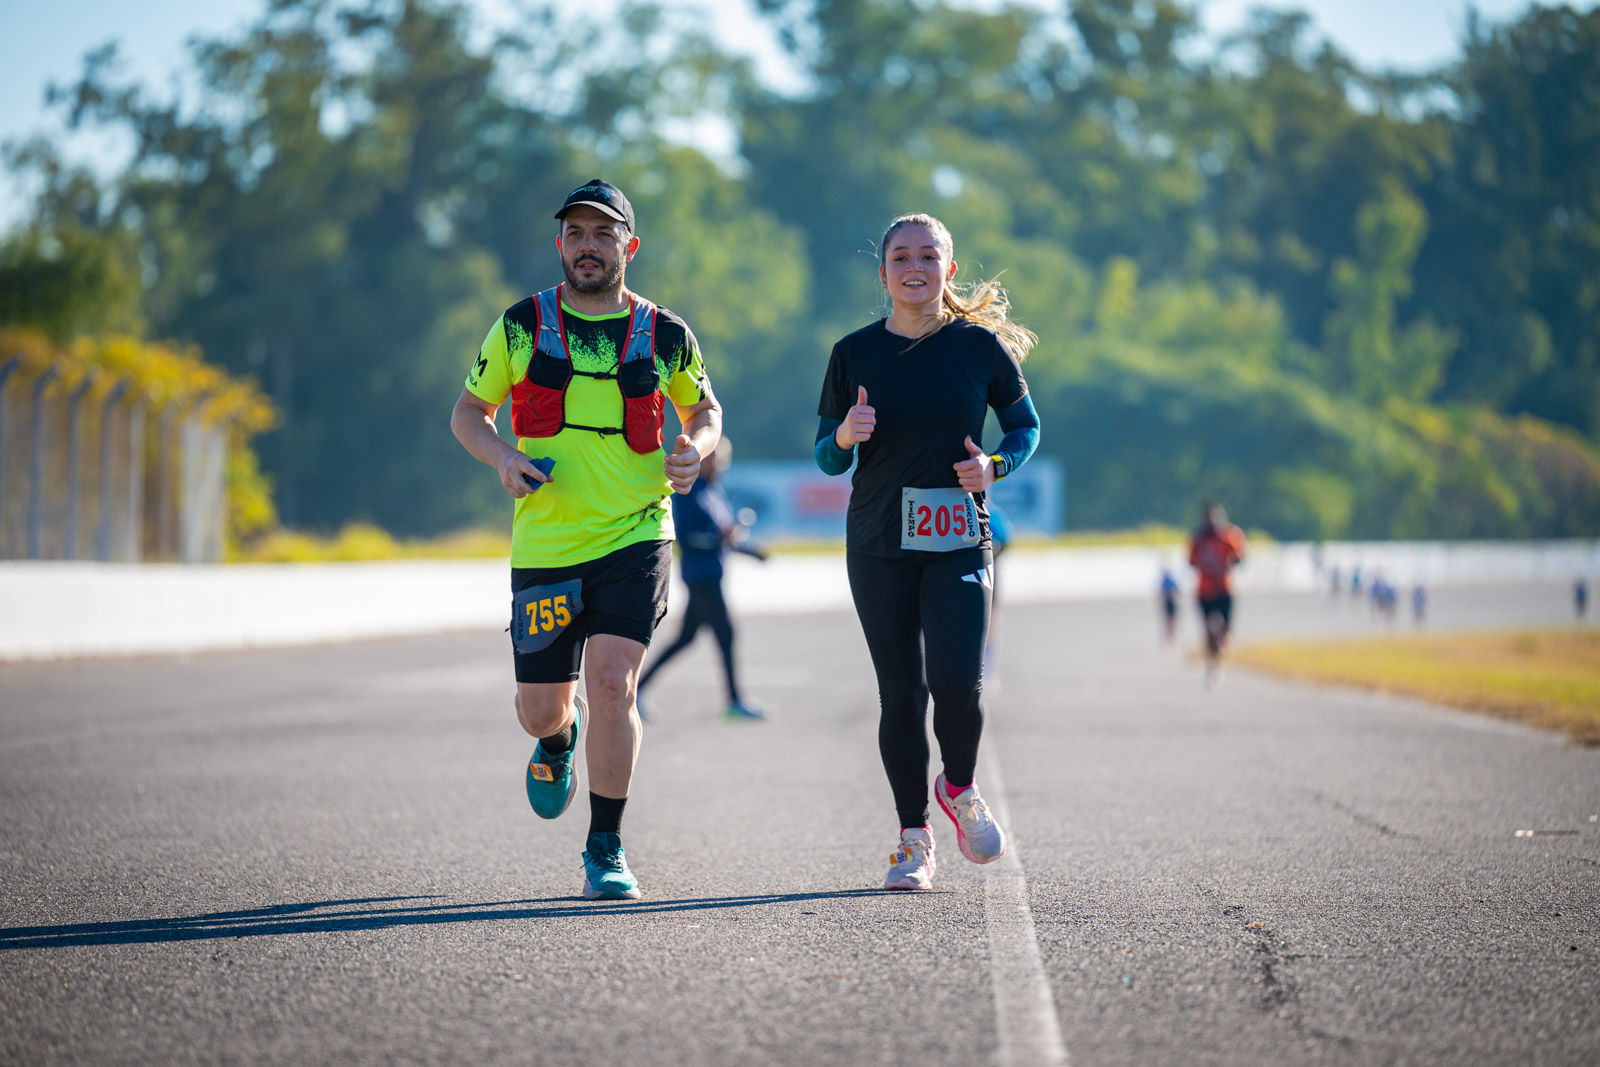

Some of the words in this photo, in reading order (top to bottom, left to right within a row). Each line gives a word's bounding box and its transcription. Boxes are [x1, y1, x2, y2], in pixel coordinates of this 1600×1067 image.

[917, 504, 967, 537] 205
[964, 498, 975, 537] EXACTO
[526, 595, 571, 636] 755
